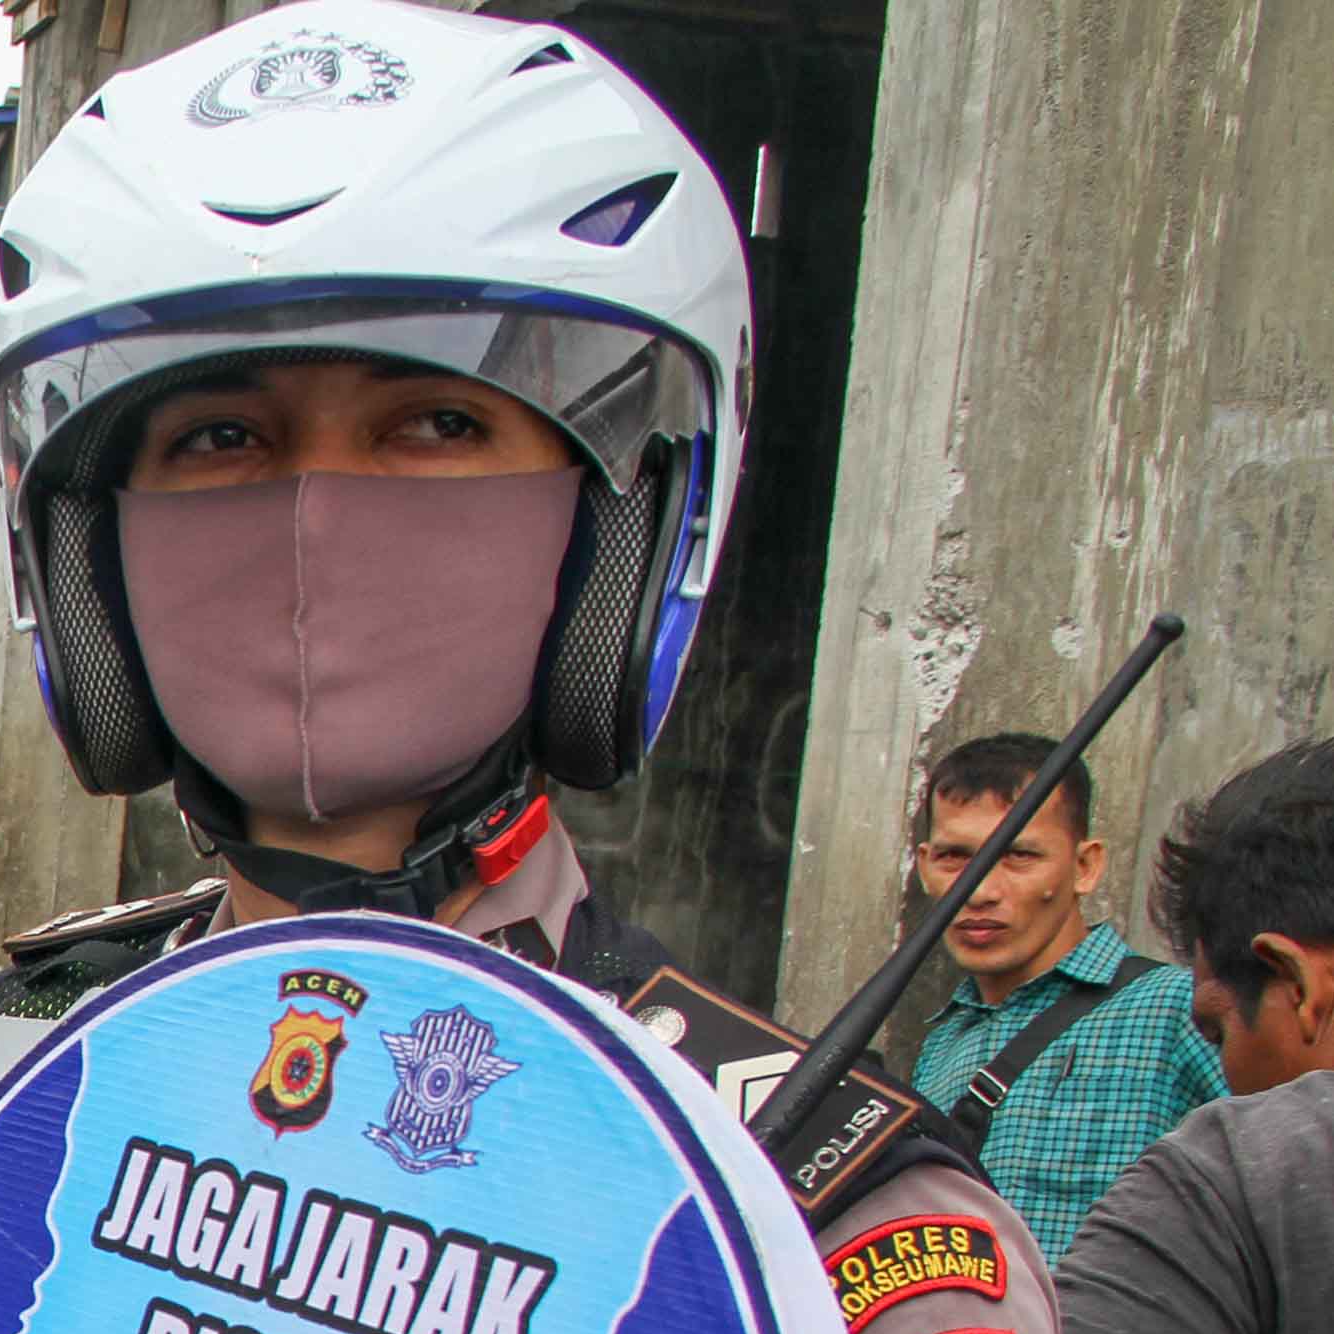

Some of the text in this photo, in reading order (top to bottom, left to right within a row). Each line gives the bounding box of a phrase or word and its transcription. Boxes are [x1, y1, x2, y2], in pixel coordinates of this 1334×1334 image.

[285, 974, 362, 1006] ACEH
[797, 1098, 890, 1189] POLISI
[95, 1142, 284, 1296] JAGA
[842, 1252, 995, 1322] OKSEUMAWE
